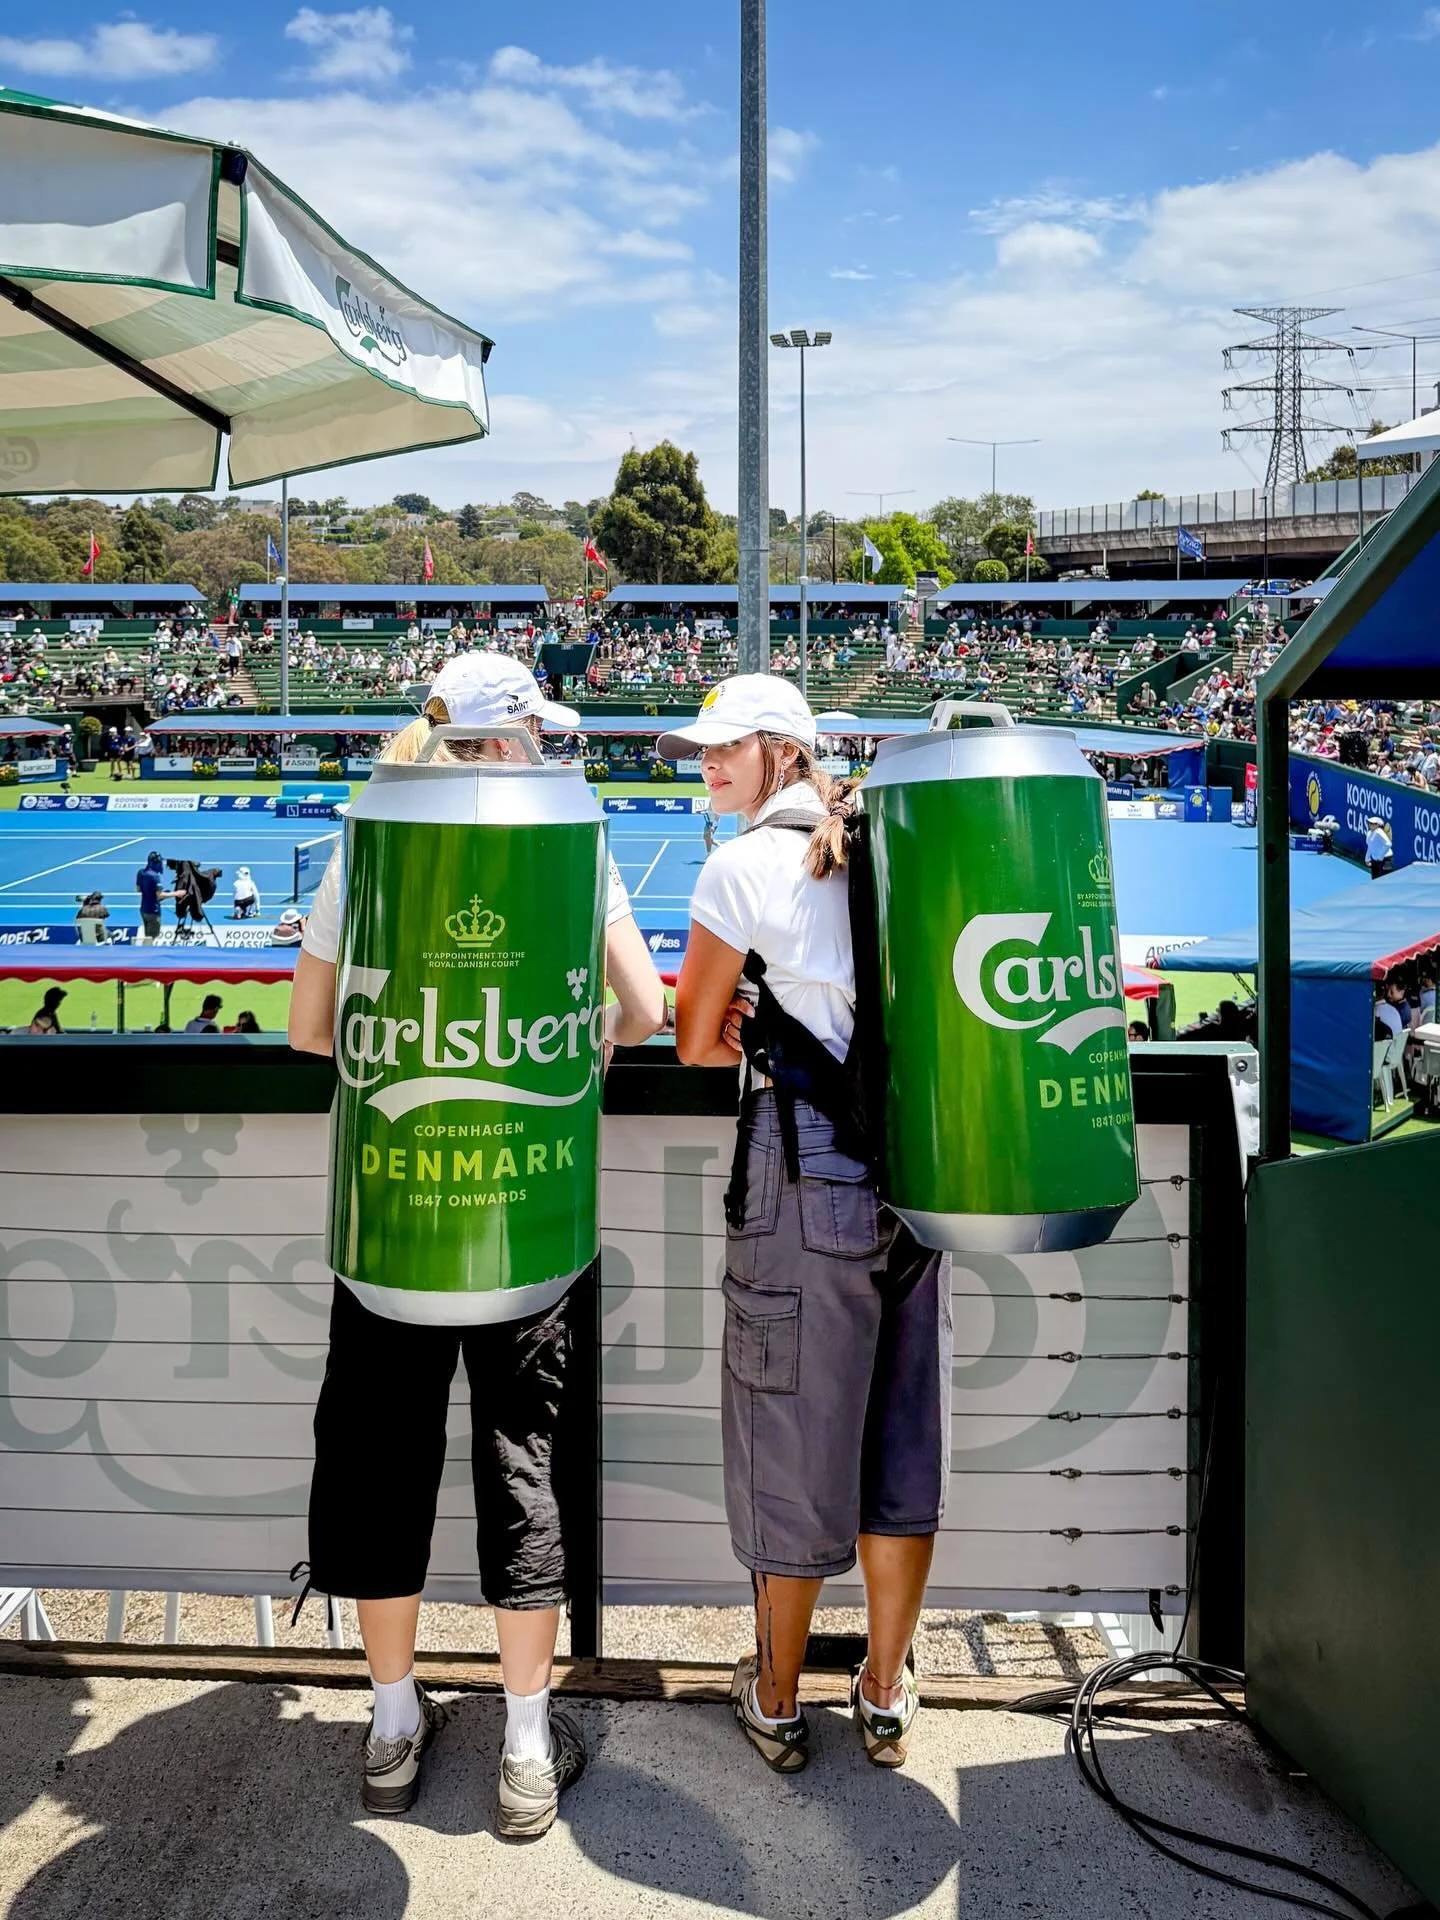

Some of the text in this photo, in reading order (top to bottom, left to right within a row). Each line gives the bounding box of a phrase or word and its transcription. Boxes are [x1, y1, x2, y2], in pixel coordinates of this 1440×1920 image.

[336, 275, 407, 361] Carlsberg
[507, 701, 529, 714] SAINT
[1346, 782, 1393, 820] KOOYONG
[1346, 808, 1369, 836] CLAS
[1414, 806, 1440, 837] KOO
[1413, 835, 1440, 863] CLA
[661, 938, 680, 948] SBS
[429, 960, 520, 968] ROYAL DANISH COURT
[435, 952, 496, 960] APPOINTMENT
[498, 951, 509, 959] TO
[510, 951, 525, 959] THE
[414, 1121, 525, 1138] COPENHAGEN
[1092, 1114, 1113, 1129] 1847
[361, 1136, 575, 1182] DENMARK
[408, 1189, 527, 1207] 1847 ONWARDS
[784, 1727, 804, 1741] Tiger
[876, 1725, 897, 1736] Tiger
